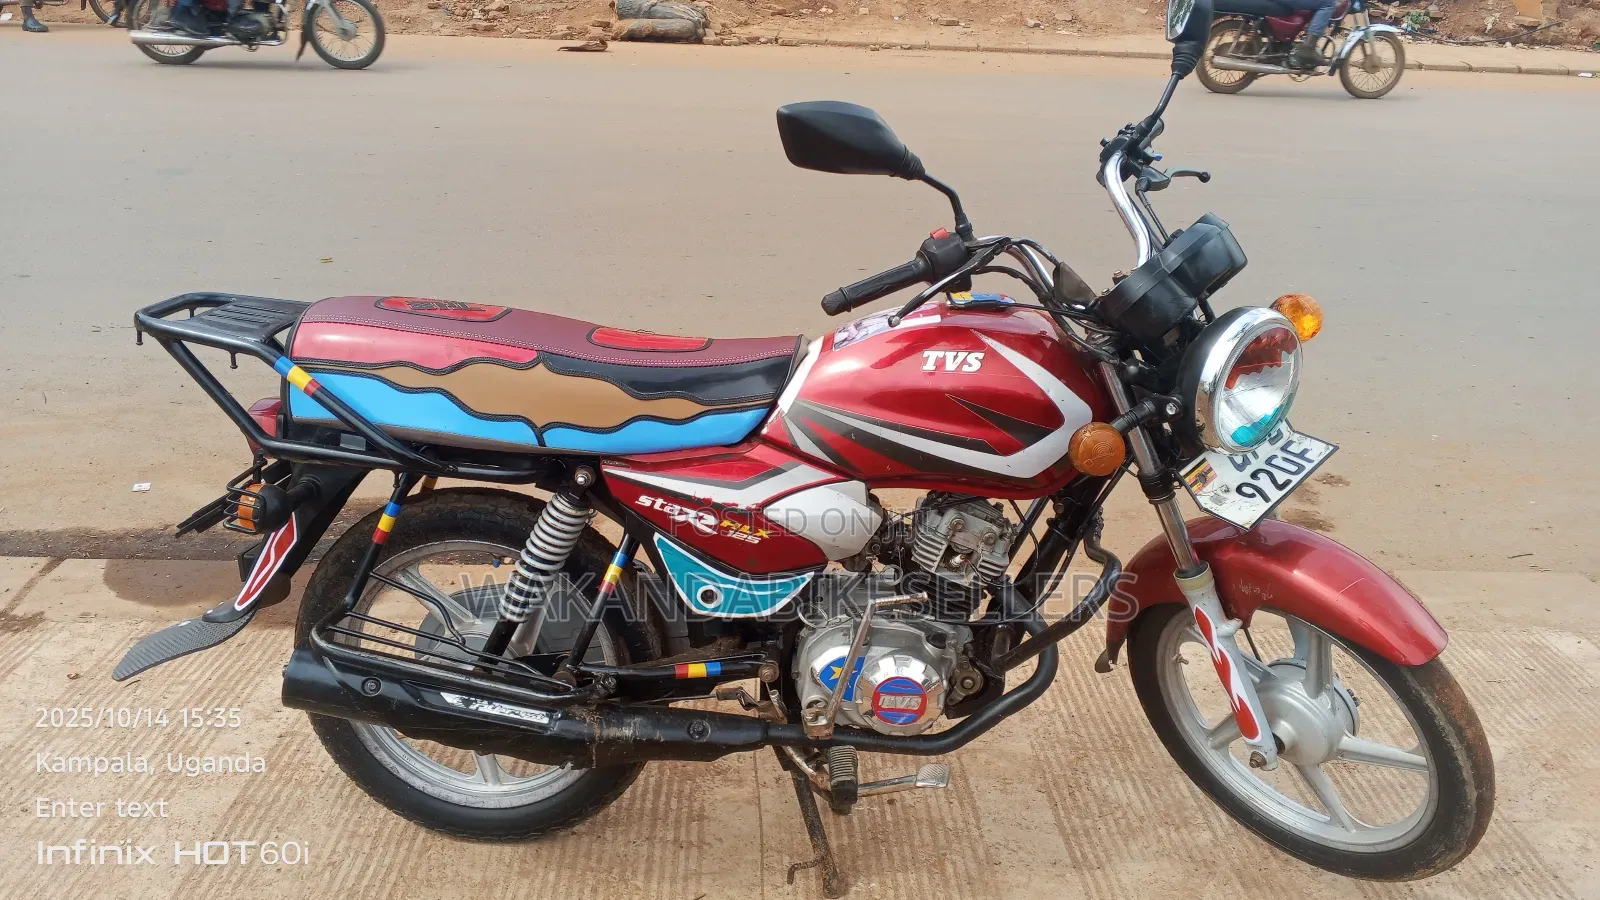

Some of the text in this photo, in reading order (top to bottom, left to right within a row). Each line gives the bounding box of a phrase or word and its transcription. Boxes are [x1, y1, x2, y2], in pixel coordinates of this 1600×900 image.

[921, 349, 985, 373] TVS
[1235, 440, 1316, 503] 920F
[727, 529, 762, 545] 125
[879, 693, 922, 711] TVS
